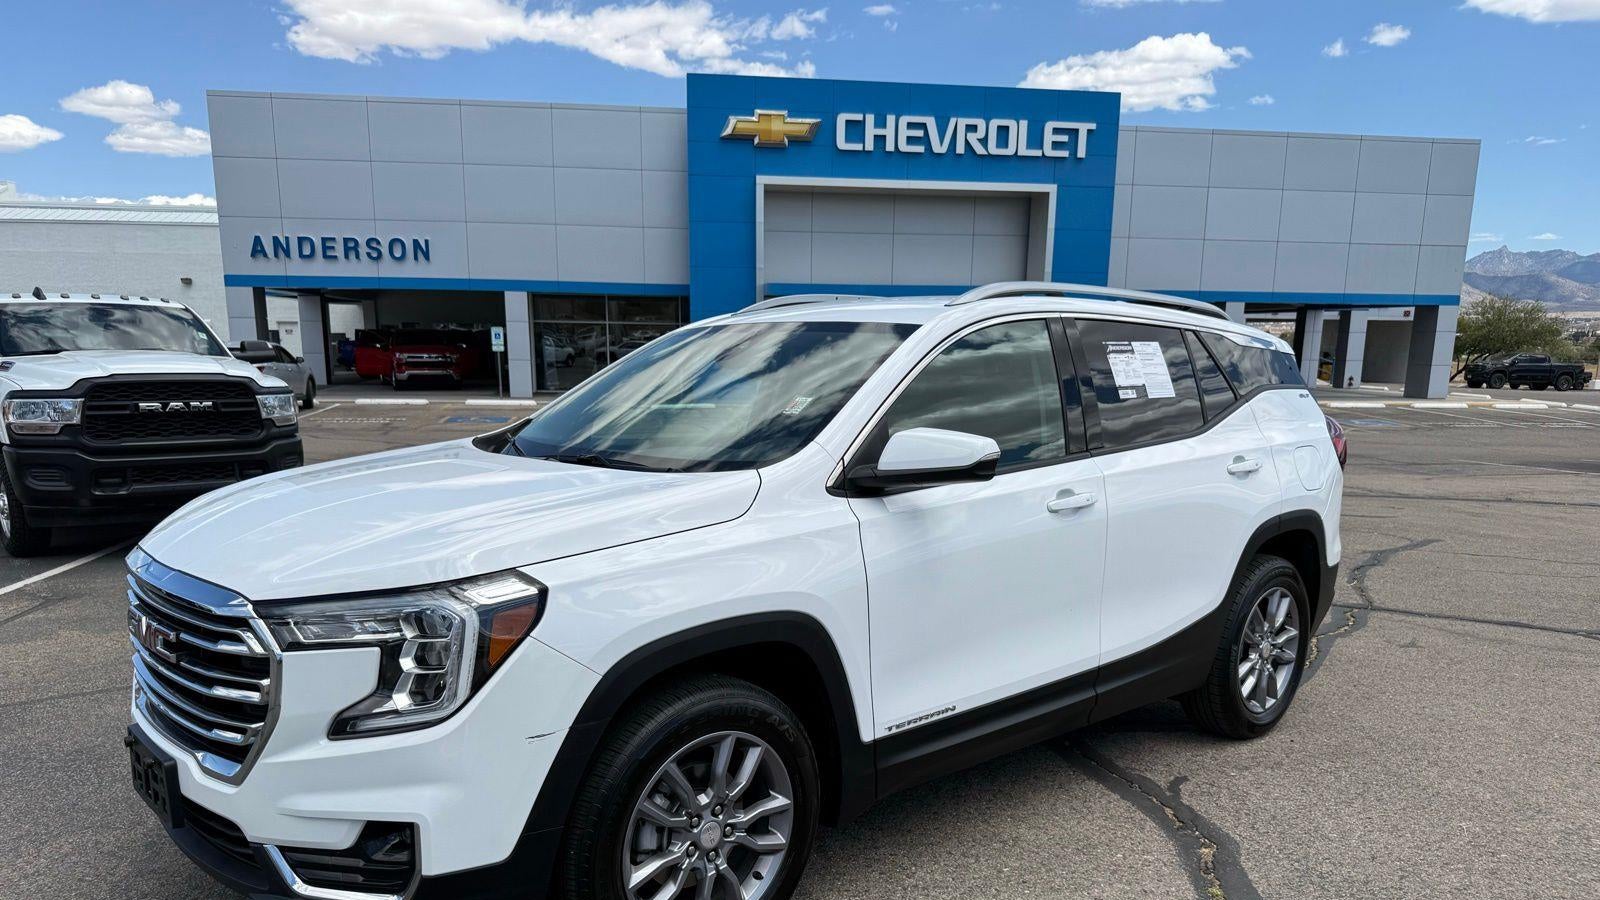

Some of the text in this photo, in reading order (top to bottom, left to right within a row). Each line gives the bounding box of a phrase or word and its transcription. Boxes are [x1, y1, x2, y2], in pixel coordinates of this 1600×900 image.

[835, 112, 1097, 159] CHEVROLET
[250, 235, 431, 262] ANDERSON
[138, 401, 216, 413] RAM
[127, 605, 177, 664] GMC
[884, 705, 957, 732] TERRAIN
